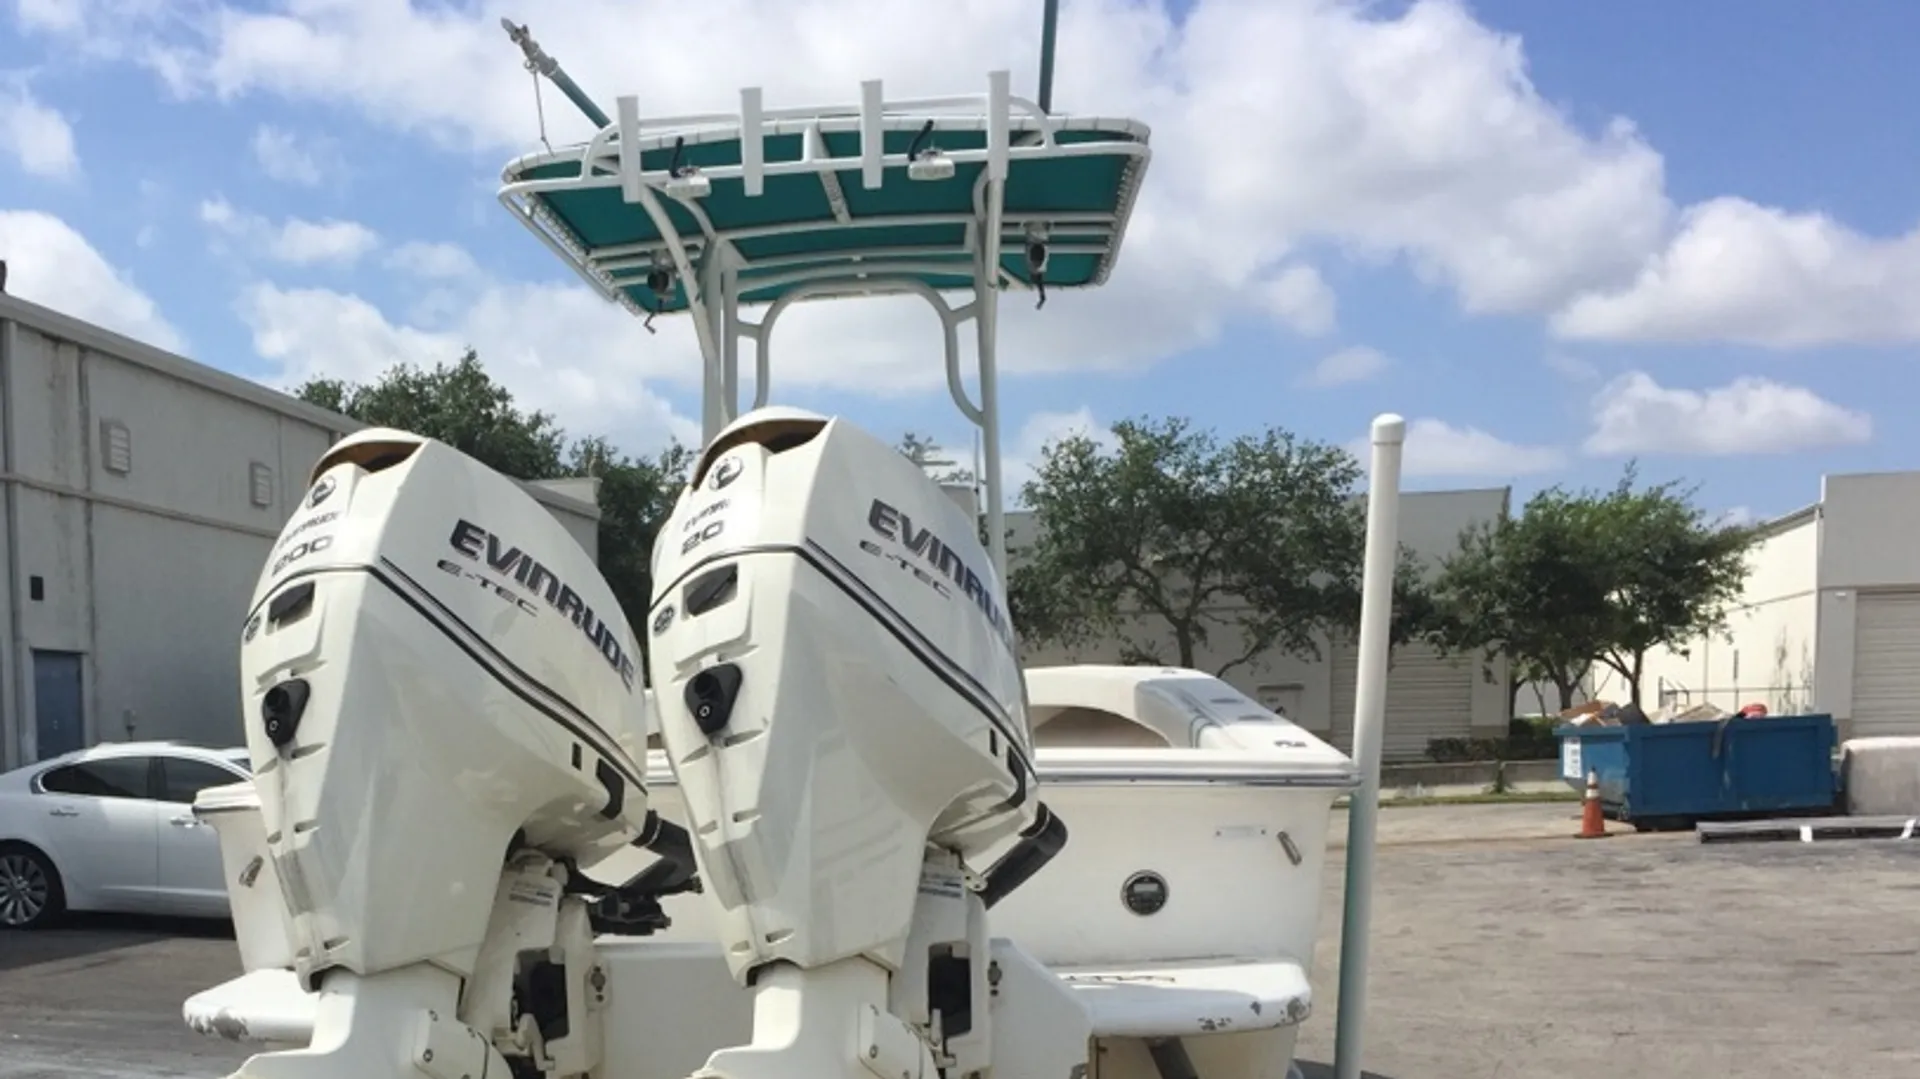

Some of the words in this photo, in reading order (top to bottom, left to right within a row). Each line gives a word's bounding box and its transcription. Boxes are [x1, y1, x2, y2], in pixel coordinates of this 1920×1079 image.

[436, 558, 539, 618] E-TEC
[449, 518, 634, 694] EVINRUDE
[859, 539, 953, 601] E-TEC
[868, 498, 1008, 640] EVINRU
